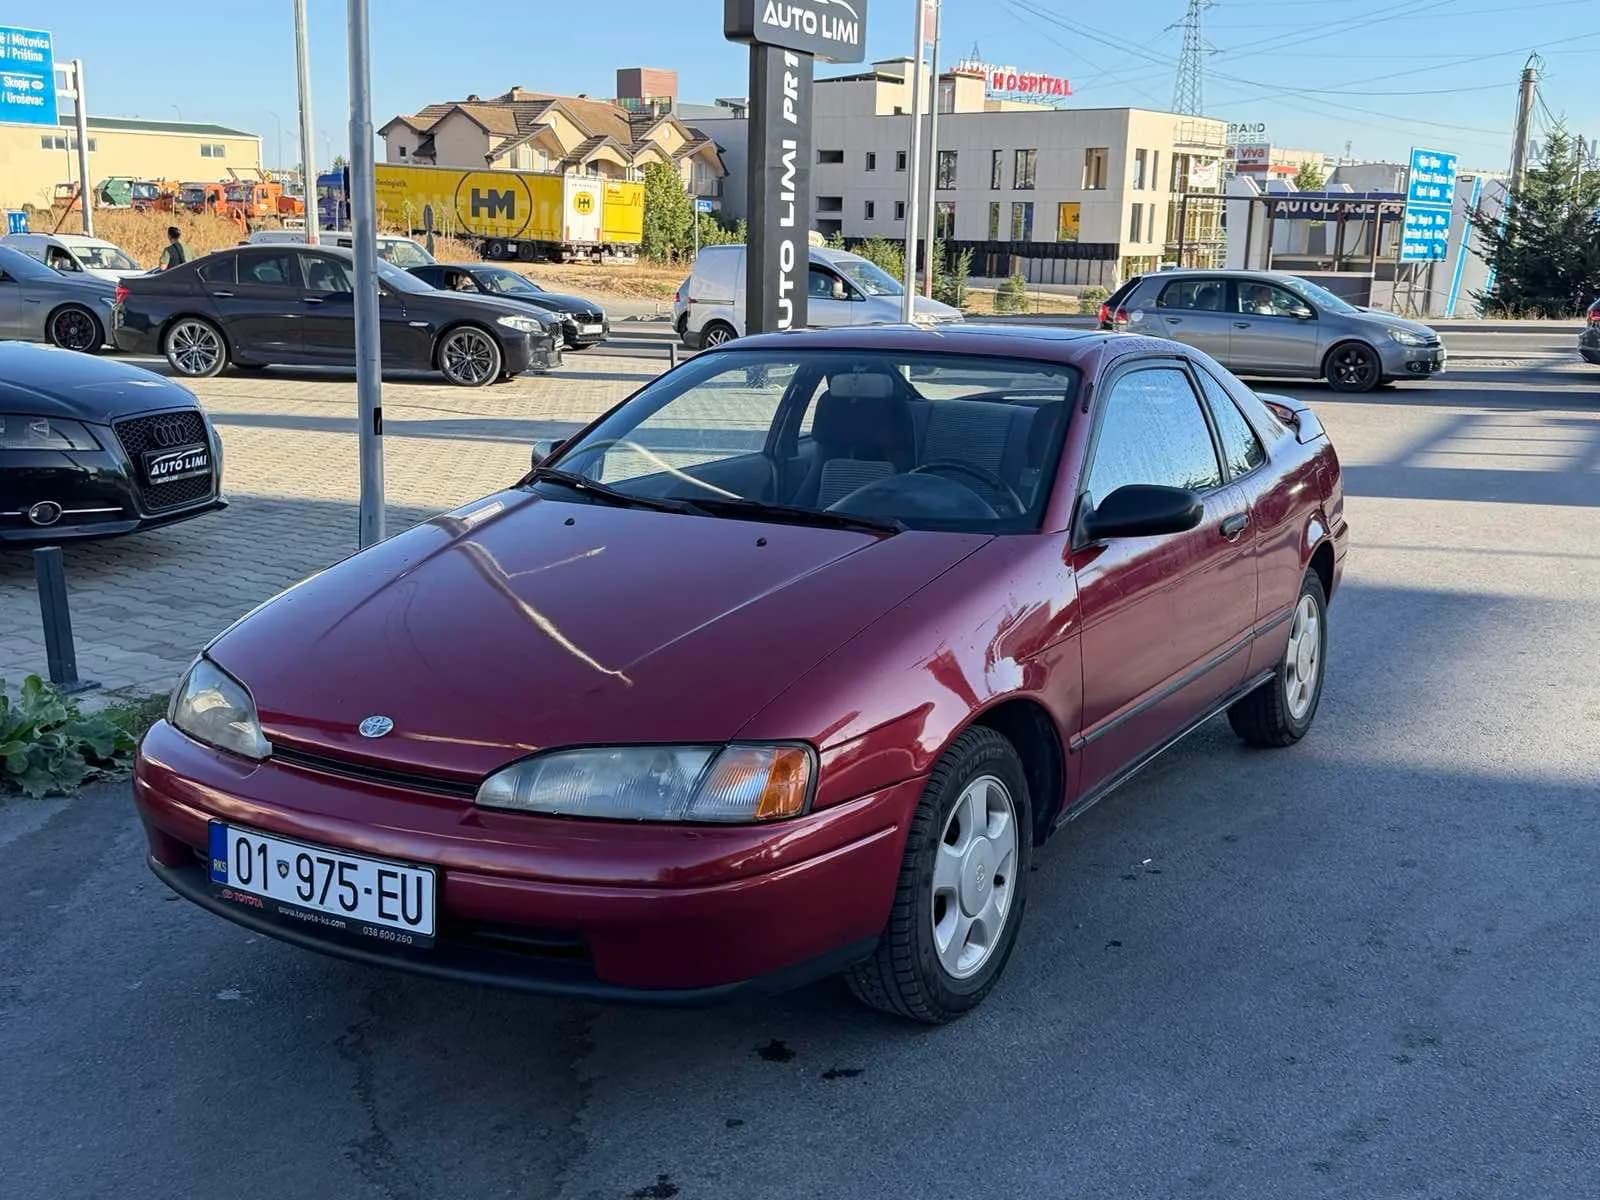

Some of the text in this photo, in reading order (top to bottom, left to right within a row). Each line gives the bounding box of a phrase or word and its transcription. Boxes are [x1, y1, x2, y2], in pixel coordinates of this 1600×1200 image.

[763, 1, 858, 45] AUTO LIMI
[993, 72, 1072, 97] HOSPITAL
[780, 139, 798, 227] LIMI
[471, 188, 516, 220] HM
[777, 239, 795, 331] UTO
[151, 455, 207, 476] AUTO LIMI
[213, 858, 227, 873] RKS
[235, 836, 423, 926] 01 975-EU
[233, 893, 265, 909] TOYOTA
[362, 925, 378, 937] 038
